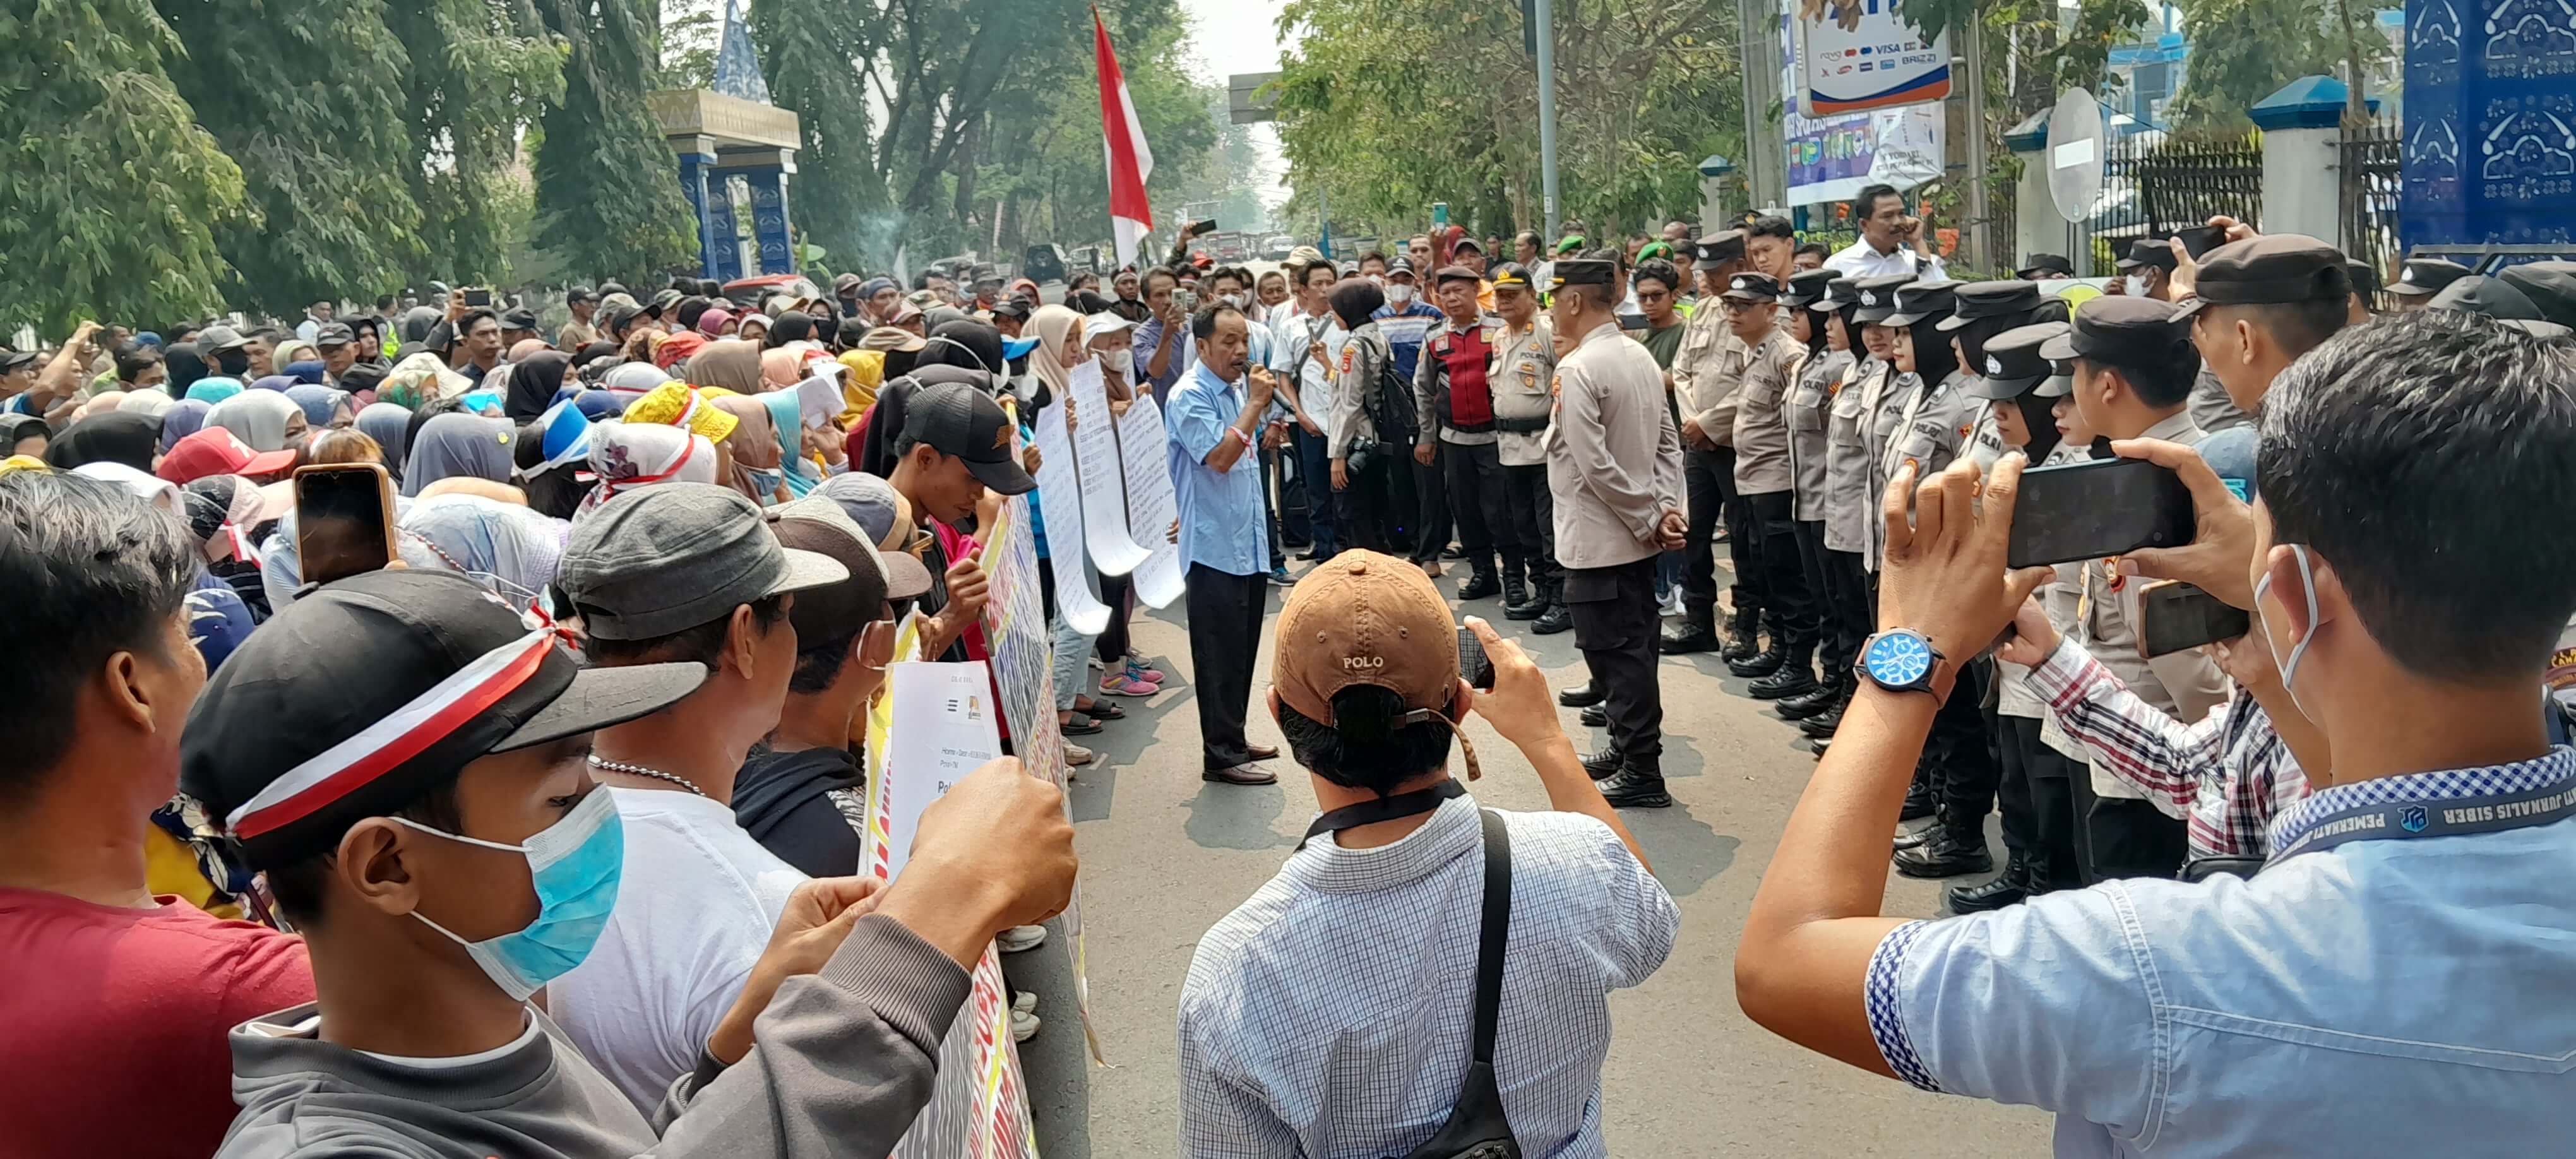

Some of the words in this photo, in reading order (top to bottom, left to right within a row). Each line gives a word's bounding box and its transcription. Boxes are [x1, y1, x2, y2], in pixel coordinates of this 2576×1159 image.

[1875, 44, 1900, 55] VISA
[1520, 352, 1546, 362] POLRI
[1912, 422, 1941, 438] POLRI
[1343, 656, 1384, 669] POLO
[2496, 793, 2563, 819] JURNALIS
[2443, 805, 2493, 824] SIBER
[2313, 812, 2386, 840] PEMERHATI
